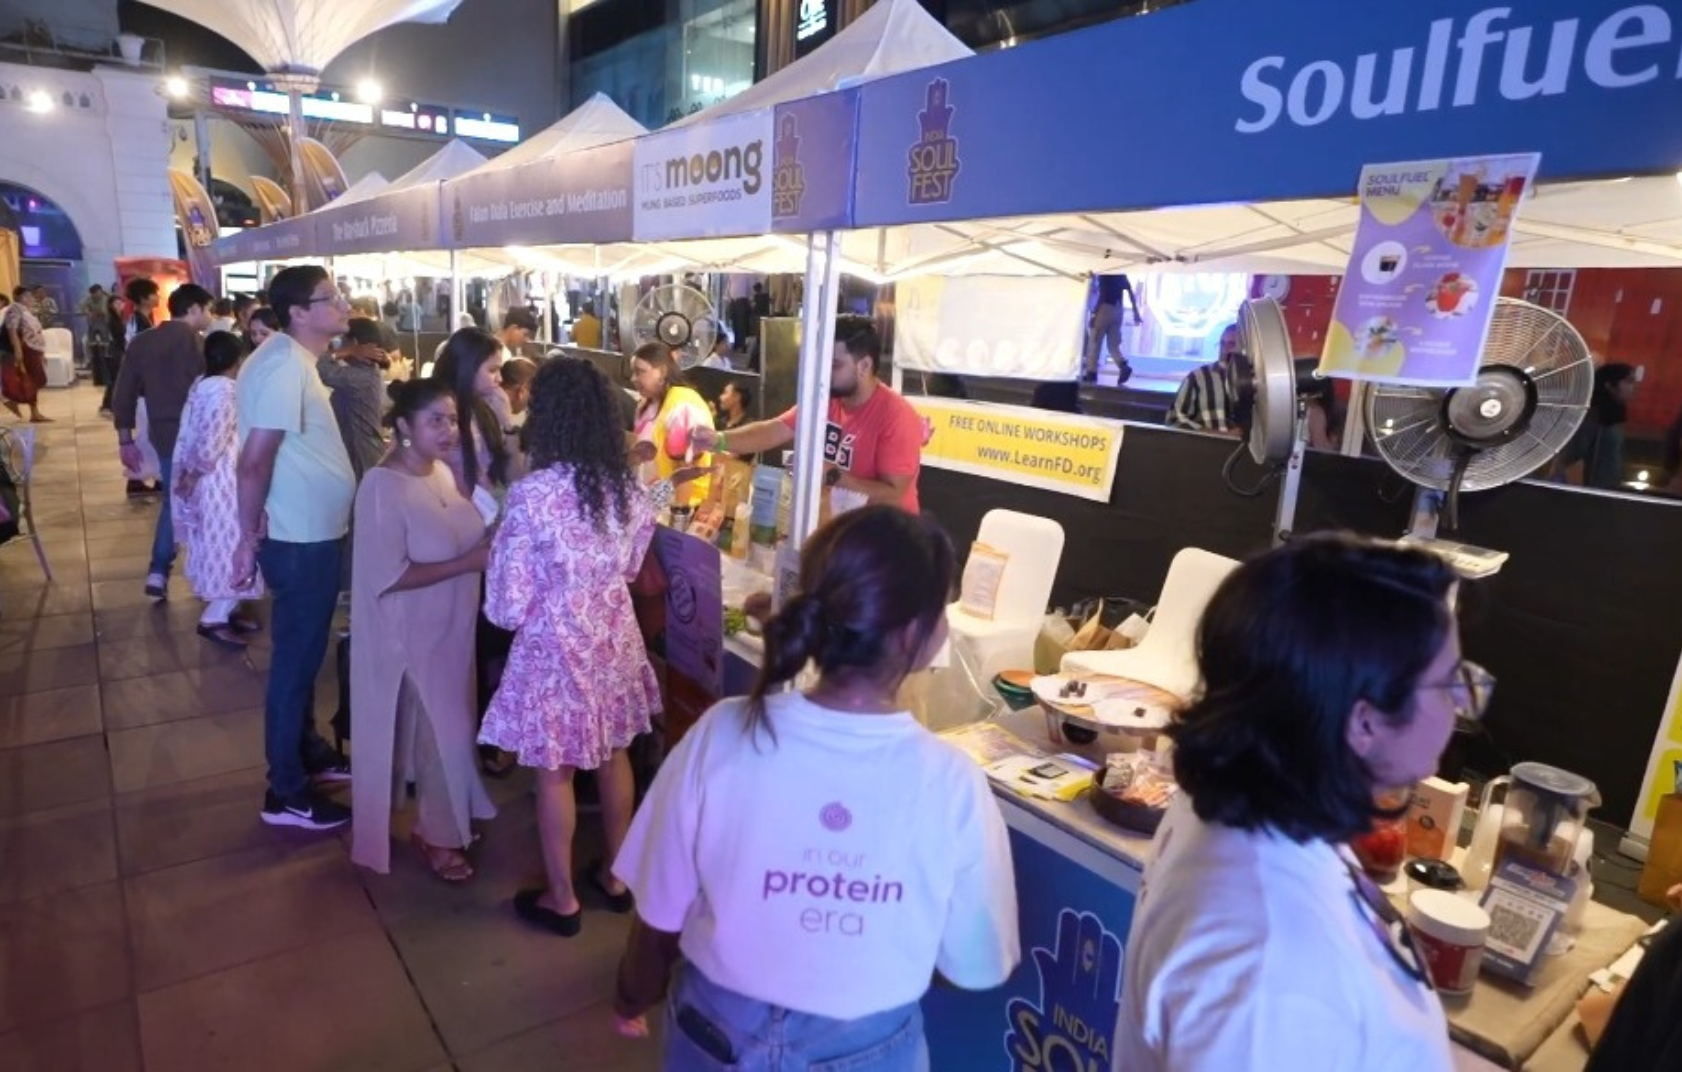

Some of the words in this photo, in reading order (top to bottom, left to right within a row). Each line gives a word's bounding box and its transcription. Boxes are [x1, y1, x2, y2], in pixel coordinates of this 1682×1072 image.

[1233, 4, 1682, 133] Soulfue
[666, 139, 763, 195] moong
[910, 141, 957, 173] SOUL
[912, 170, 953, 201] FEST
[1366, 169, 1432, 187] SOULFUEL
[1366, 184, 1401, 198] MENU
[510, 199, 544, 219] Exercise
[546, 194, 565, 215] and
[568, 189, 627, 213] Meditation
[663, 197, 686, 209] BASED
[688, 189, 742, 206] SUPERFOODS
[950, 414, 974, 432] FREE
[976, 419, 1021, 438] ONLINE
[1024, 426, 1107, 452] WORKSHOPS
[977, 446, 1103, 484] www.LearnFD.org
[828, 849, 865, 868] our
[763, 870, 904, 904] protein
[800, 907, 864, 937] era
[1053, 1002, 1109, 1063] INDIA
